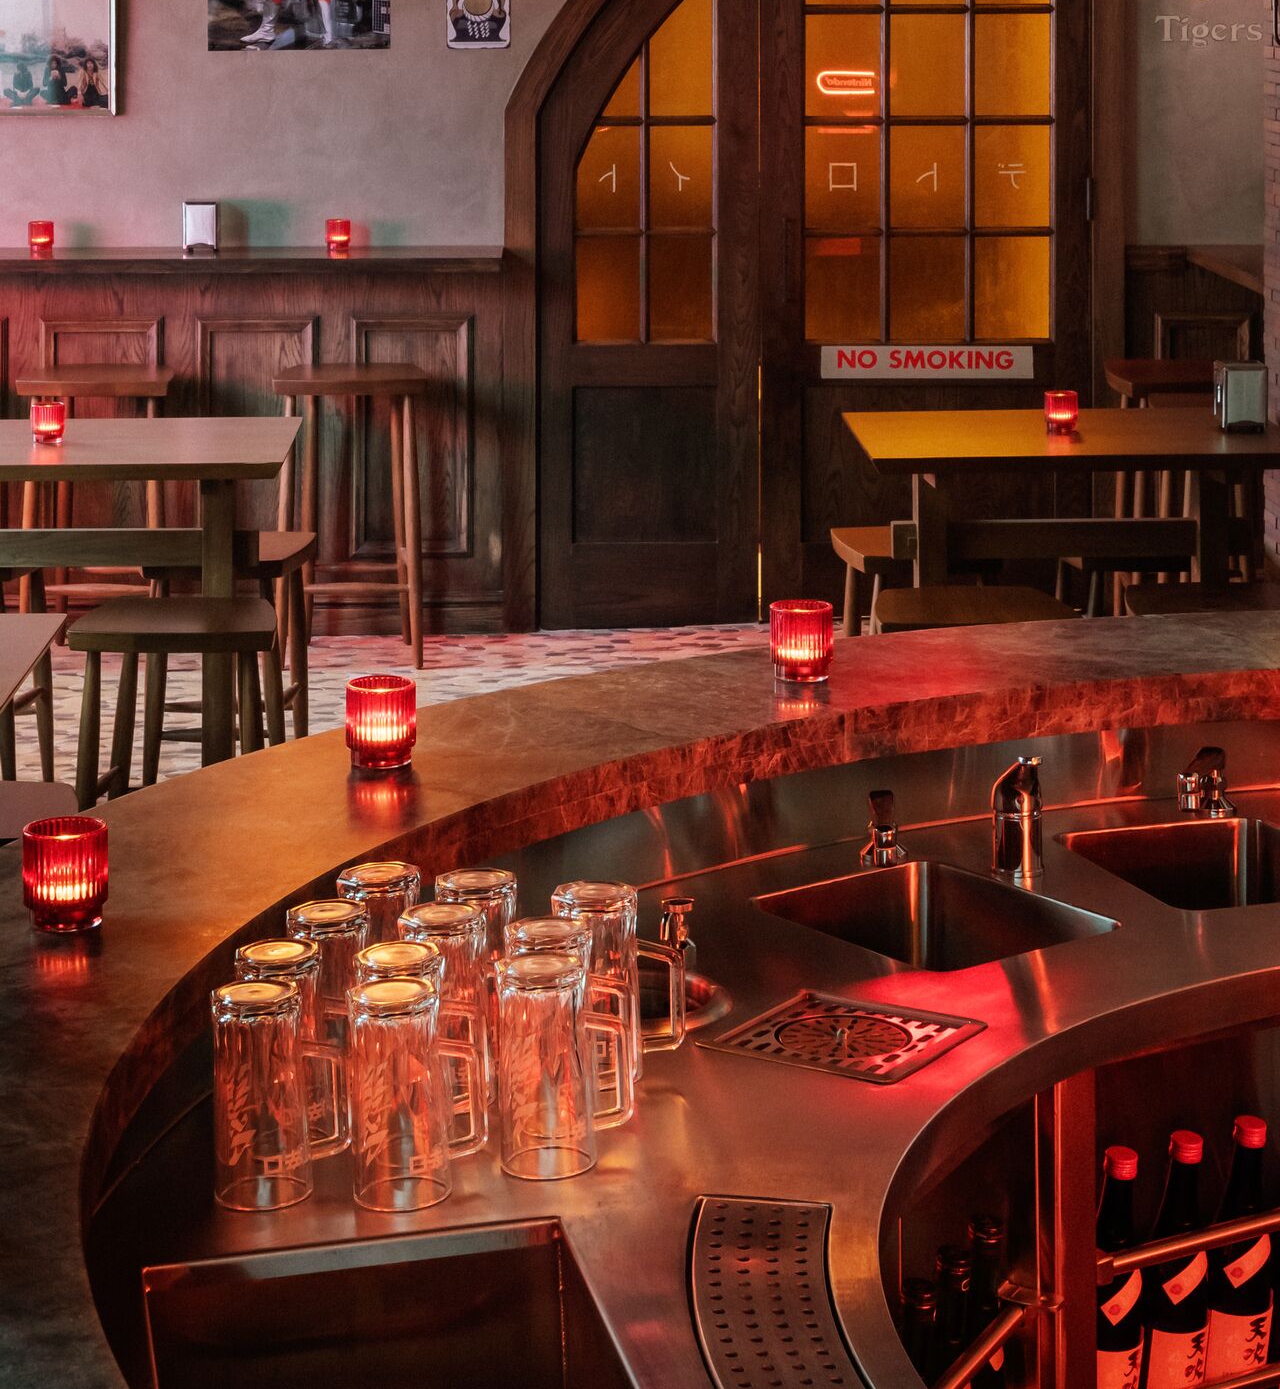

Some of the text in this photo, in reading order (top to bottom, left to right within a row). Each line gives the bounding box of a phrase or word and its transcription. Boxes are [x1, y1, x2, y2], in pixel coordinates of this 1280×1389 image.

[1154, 15, 1263, 48] Tigers
[837, 349, 1015, 370] NO SMOKING
[1184, 1331, 1206, 1383] 天吹
[1243, 1315, 1268, 1366] 天吹
